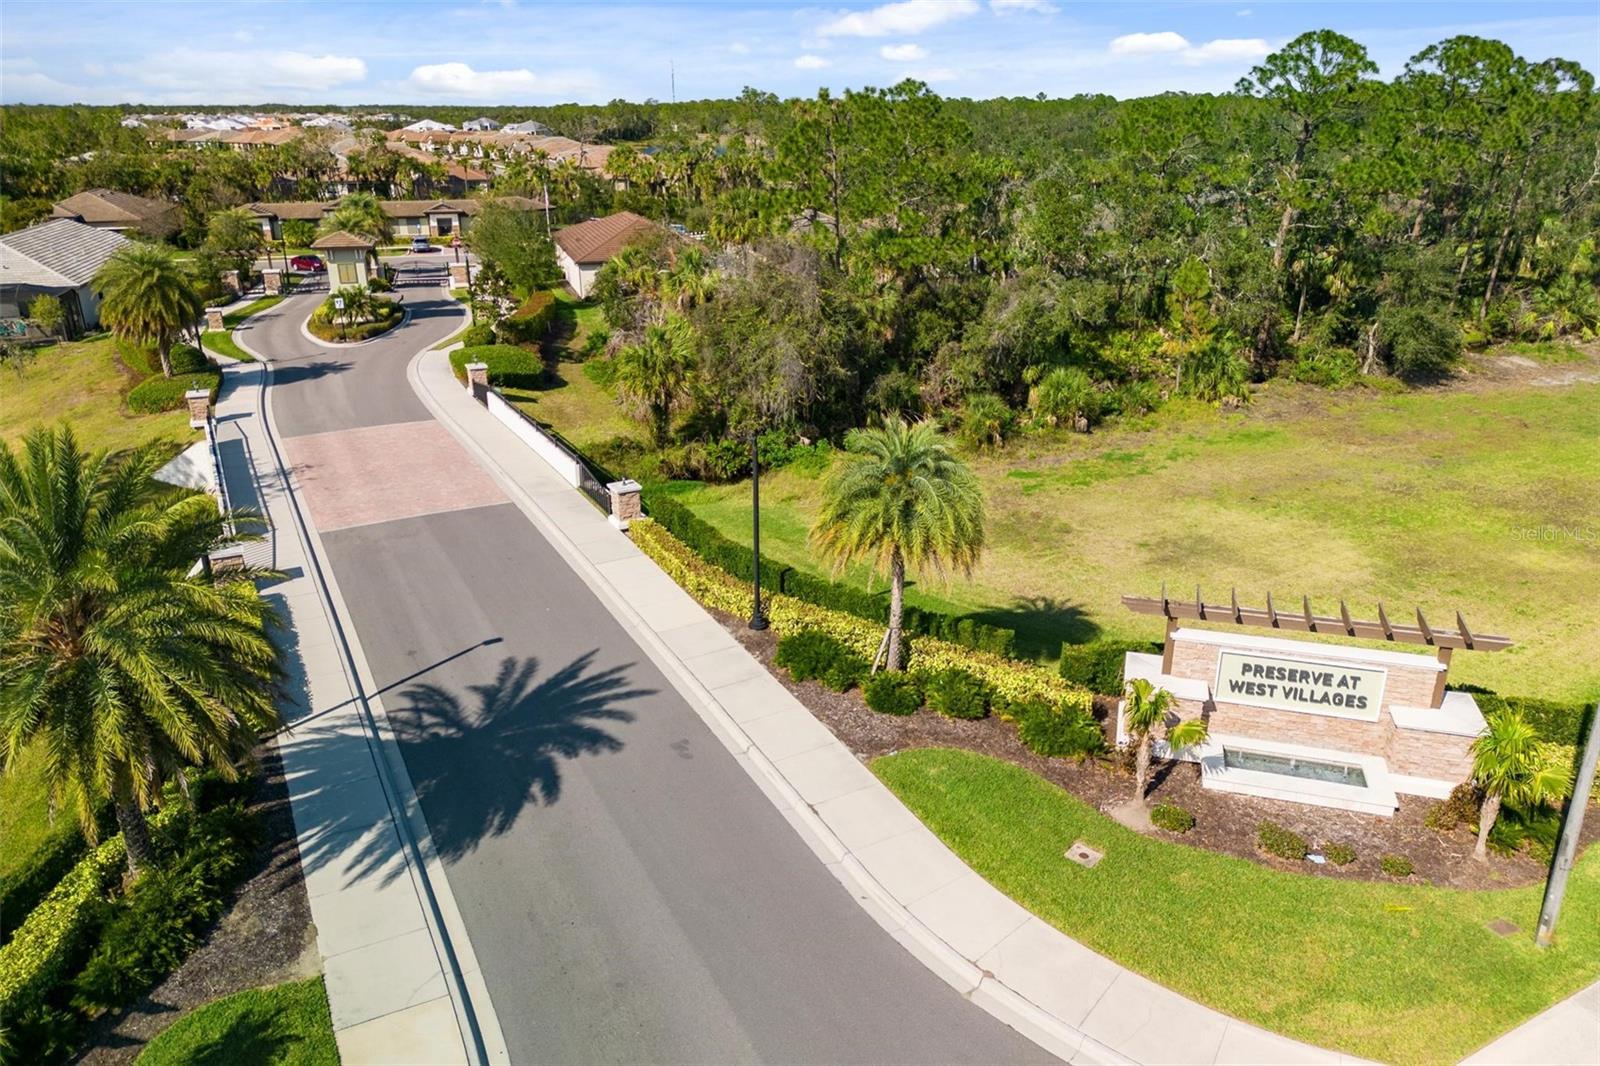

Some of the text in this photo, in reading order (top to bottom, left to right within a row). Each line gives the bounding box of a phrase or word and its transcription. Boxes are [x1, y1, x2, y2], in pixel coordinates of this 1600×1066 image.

[1241, 663, 1361, 690] PRESERVE AT
[1229, 679, 1368, 709] WEST VILLAGES
